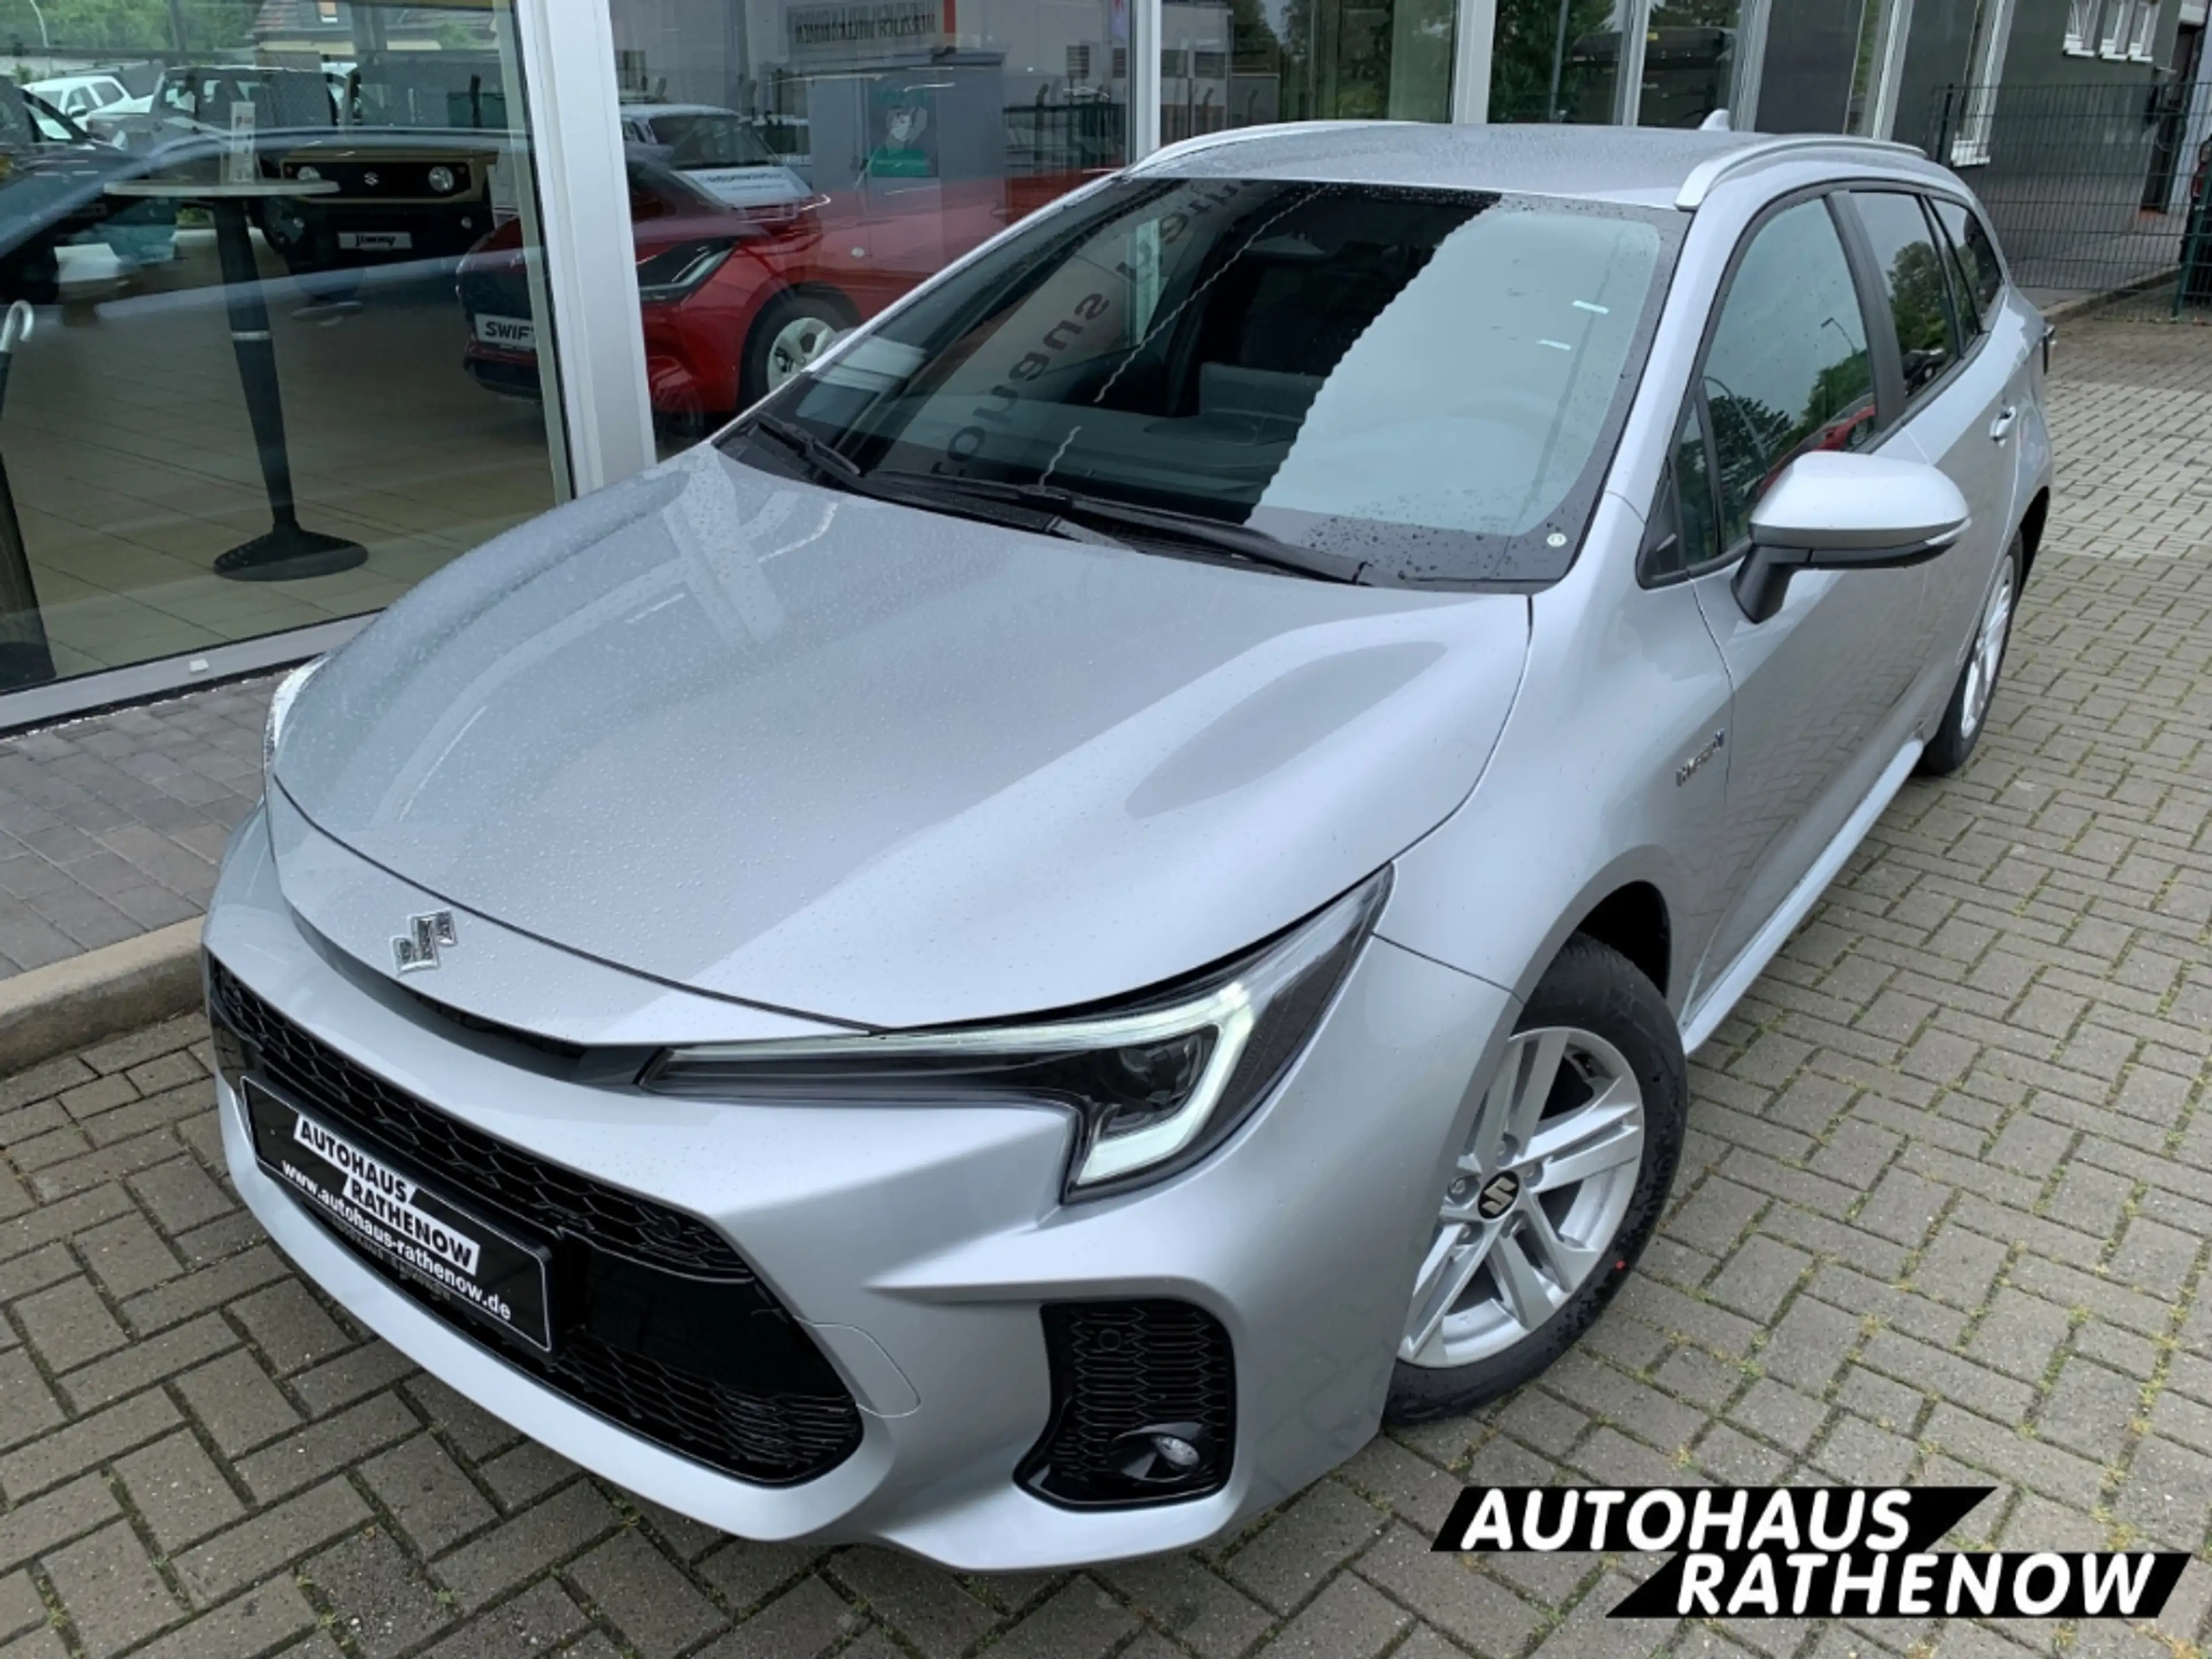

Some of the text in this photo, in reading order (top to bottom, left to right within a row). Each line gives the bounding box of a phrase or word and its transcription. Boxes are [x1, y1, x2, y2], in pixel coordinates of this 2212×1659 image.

[485, 321, 534, 340] SWIF
[301, 1120, 408, 1202] AUTOHAUS
[281, 1160, 512, 1321] www.autohaus-rathenow.de
[351, 1179, 473, 1268] RATHENOW
